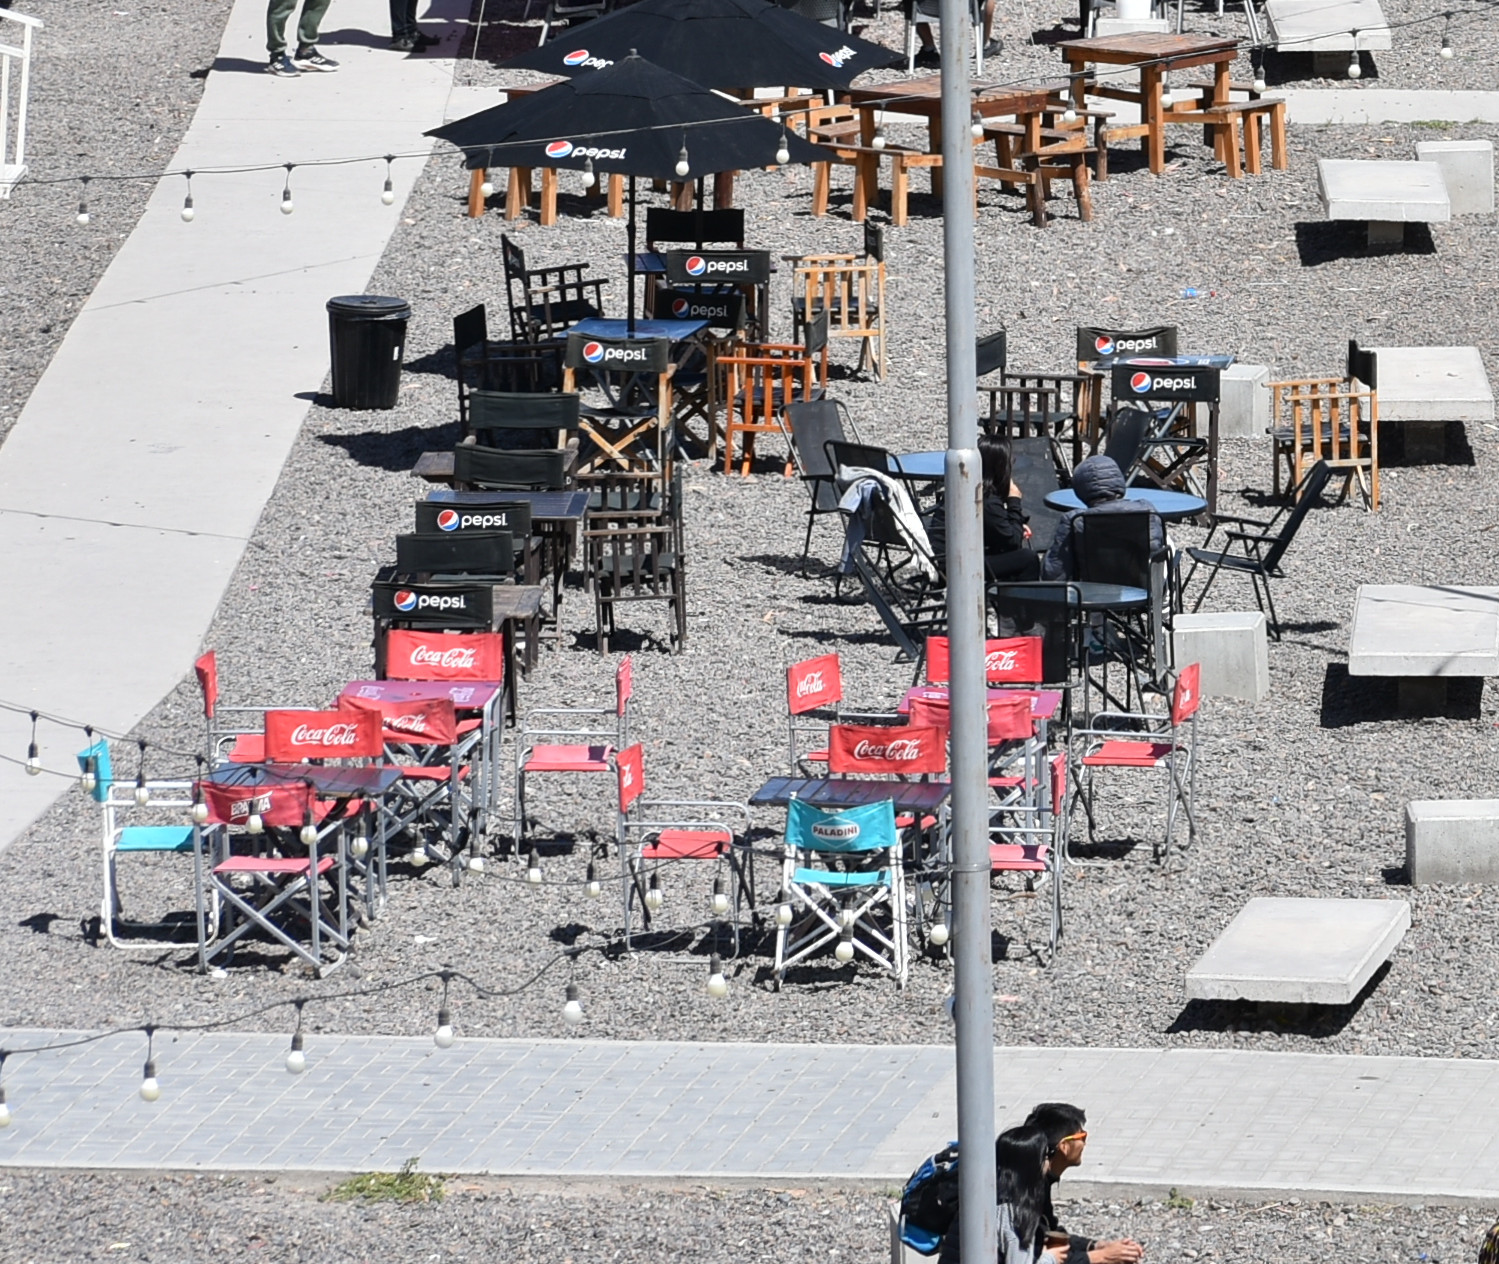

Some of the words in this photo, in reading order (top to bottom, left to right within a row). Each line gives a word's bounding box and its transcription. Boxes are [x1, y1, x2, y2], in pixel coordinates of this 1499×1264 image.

[572, 146, 627, 160] pepsi
[707, 259, 749, 273] pepsi
[690, 303, 728, 317] pepsi
[1116, 336, 1158, 352] pepsi
[605, 347, 647, 362] pepsi
[1153, 376, 1197, 392] pepsi
[461, 513, 508, 529] pepsi
[418, 593, 466, 610] pepsi
[812, 824, 860, 837] PALADINI
